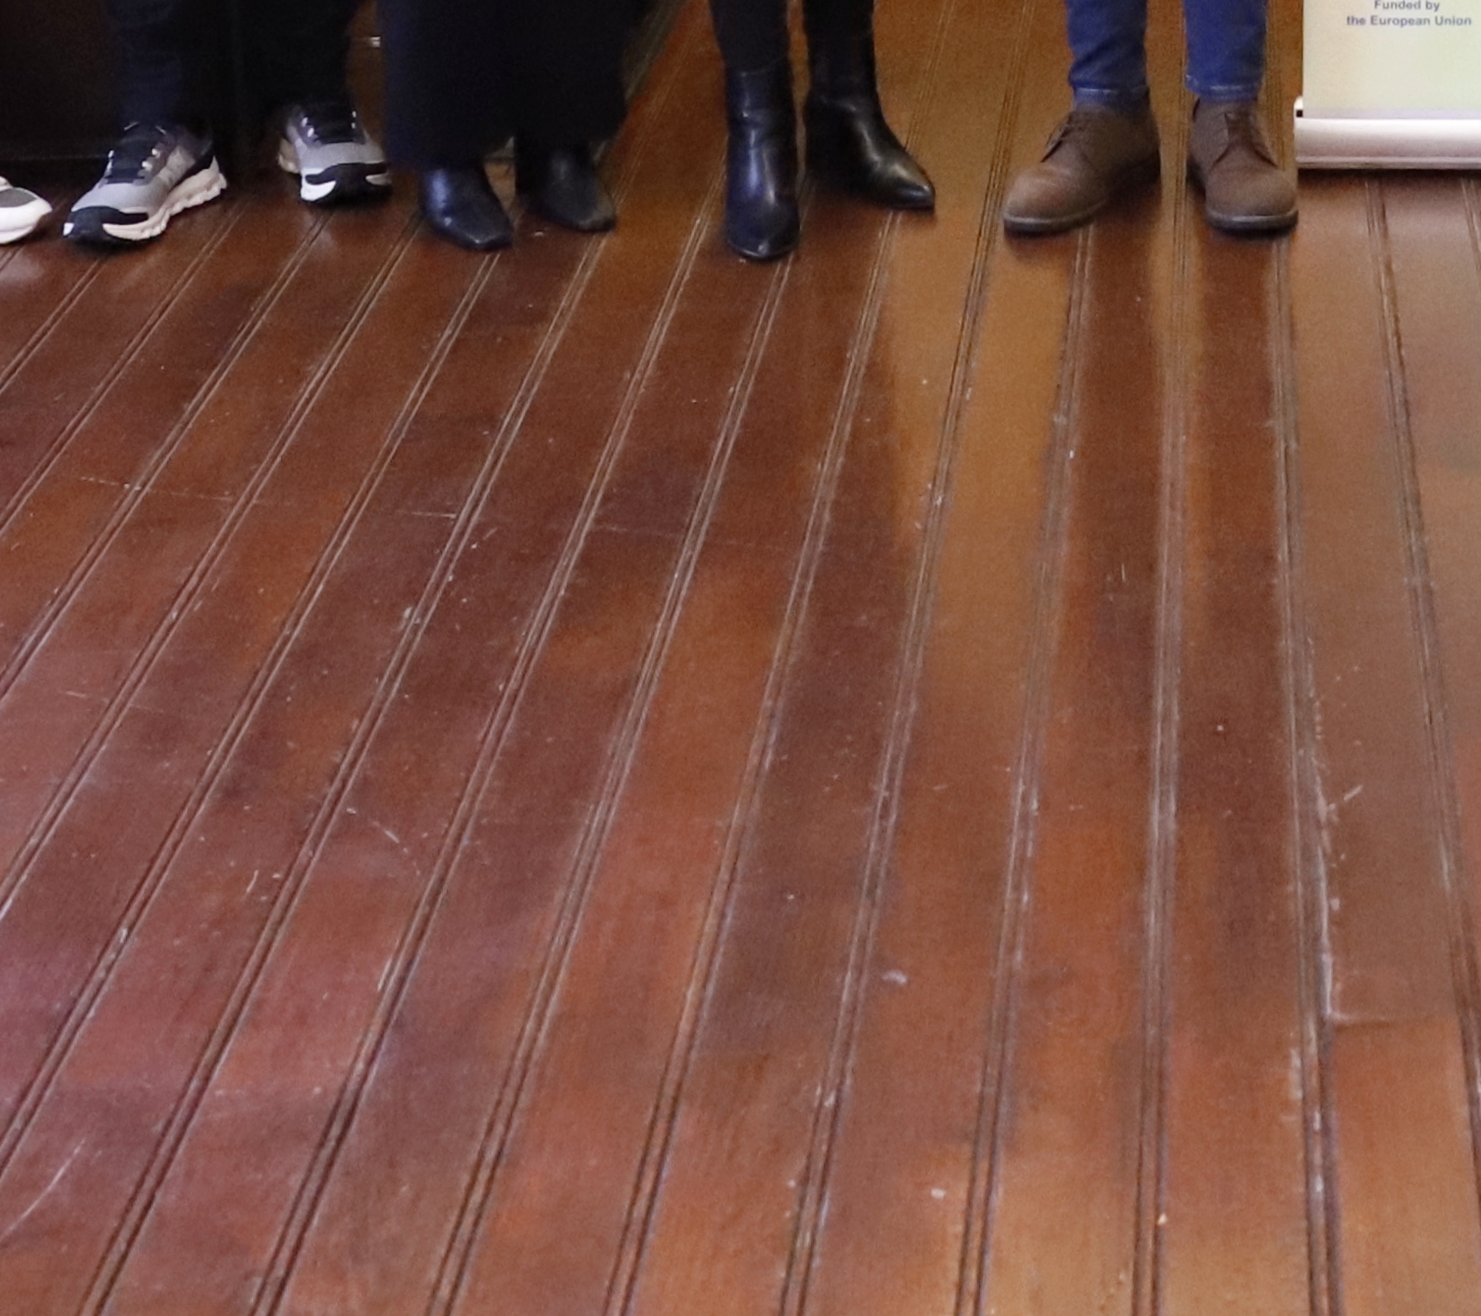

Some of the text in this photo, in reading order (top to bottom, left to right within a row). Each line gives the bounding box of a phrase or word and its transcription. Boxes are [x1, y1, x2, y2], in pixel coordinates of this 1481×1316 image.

[1425, 0, 1440, 12] by
[1346, 14, 1472, 27] the European Union
